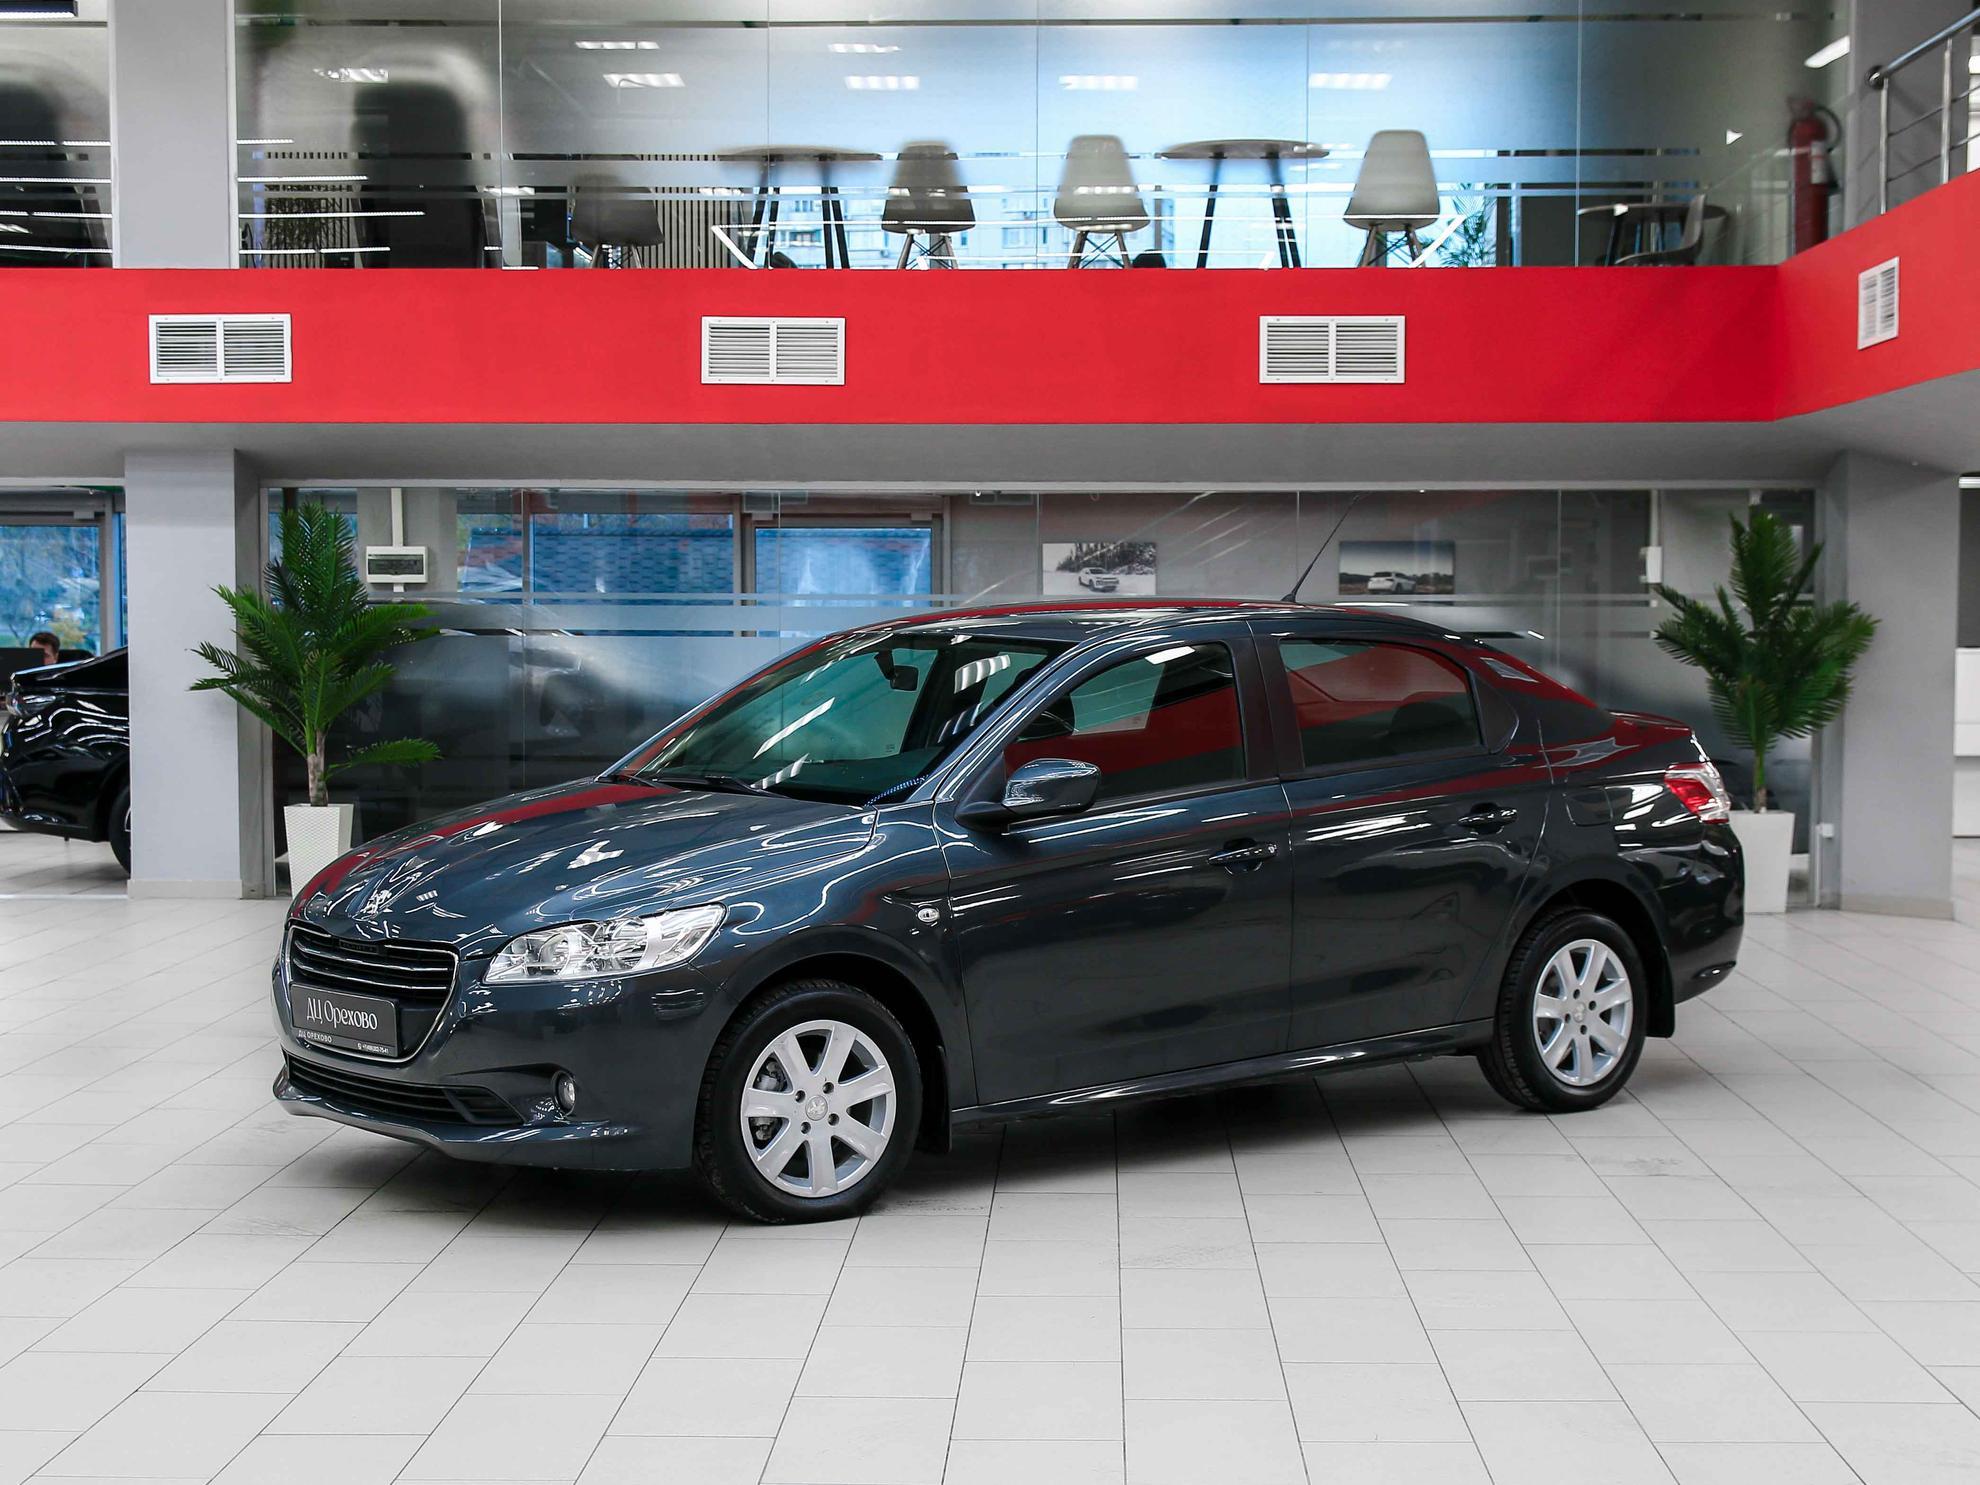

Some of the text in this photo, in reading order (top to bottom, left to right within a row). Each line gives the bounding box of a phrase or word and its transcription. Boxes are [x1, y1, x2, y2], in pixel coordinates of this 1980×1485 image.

[306, 997, 378, 1030] ДЦ Орехово
[307, 1031, 332, 1043] ОРЕХОВО
